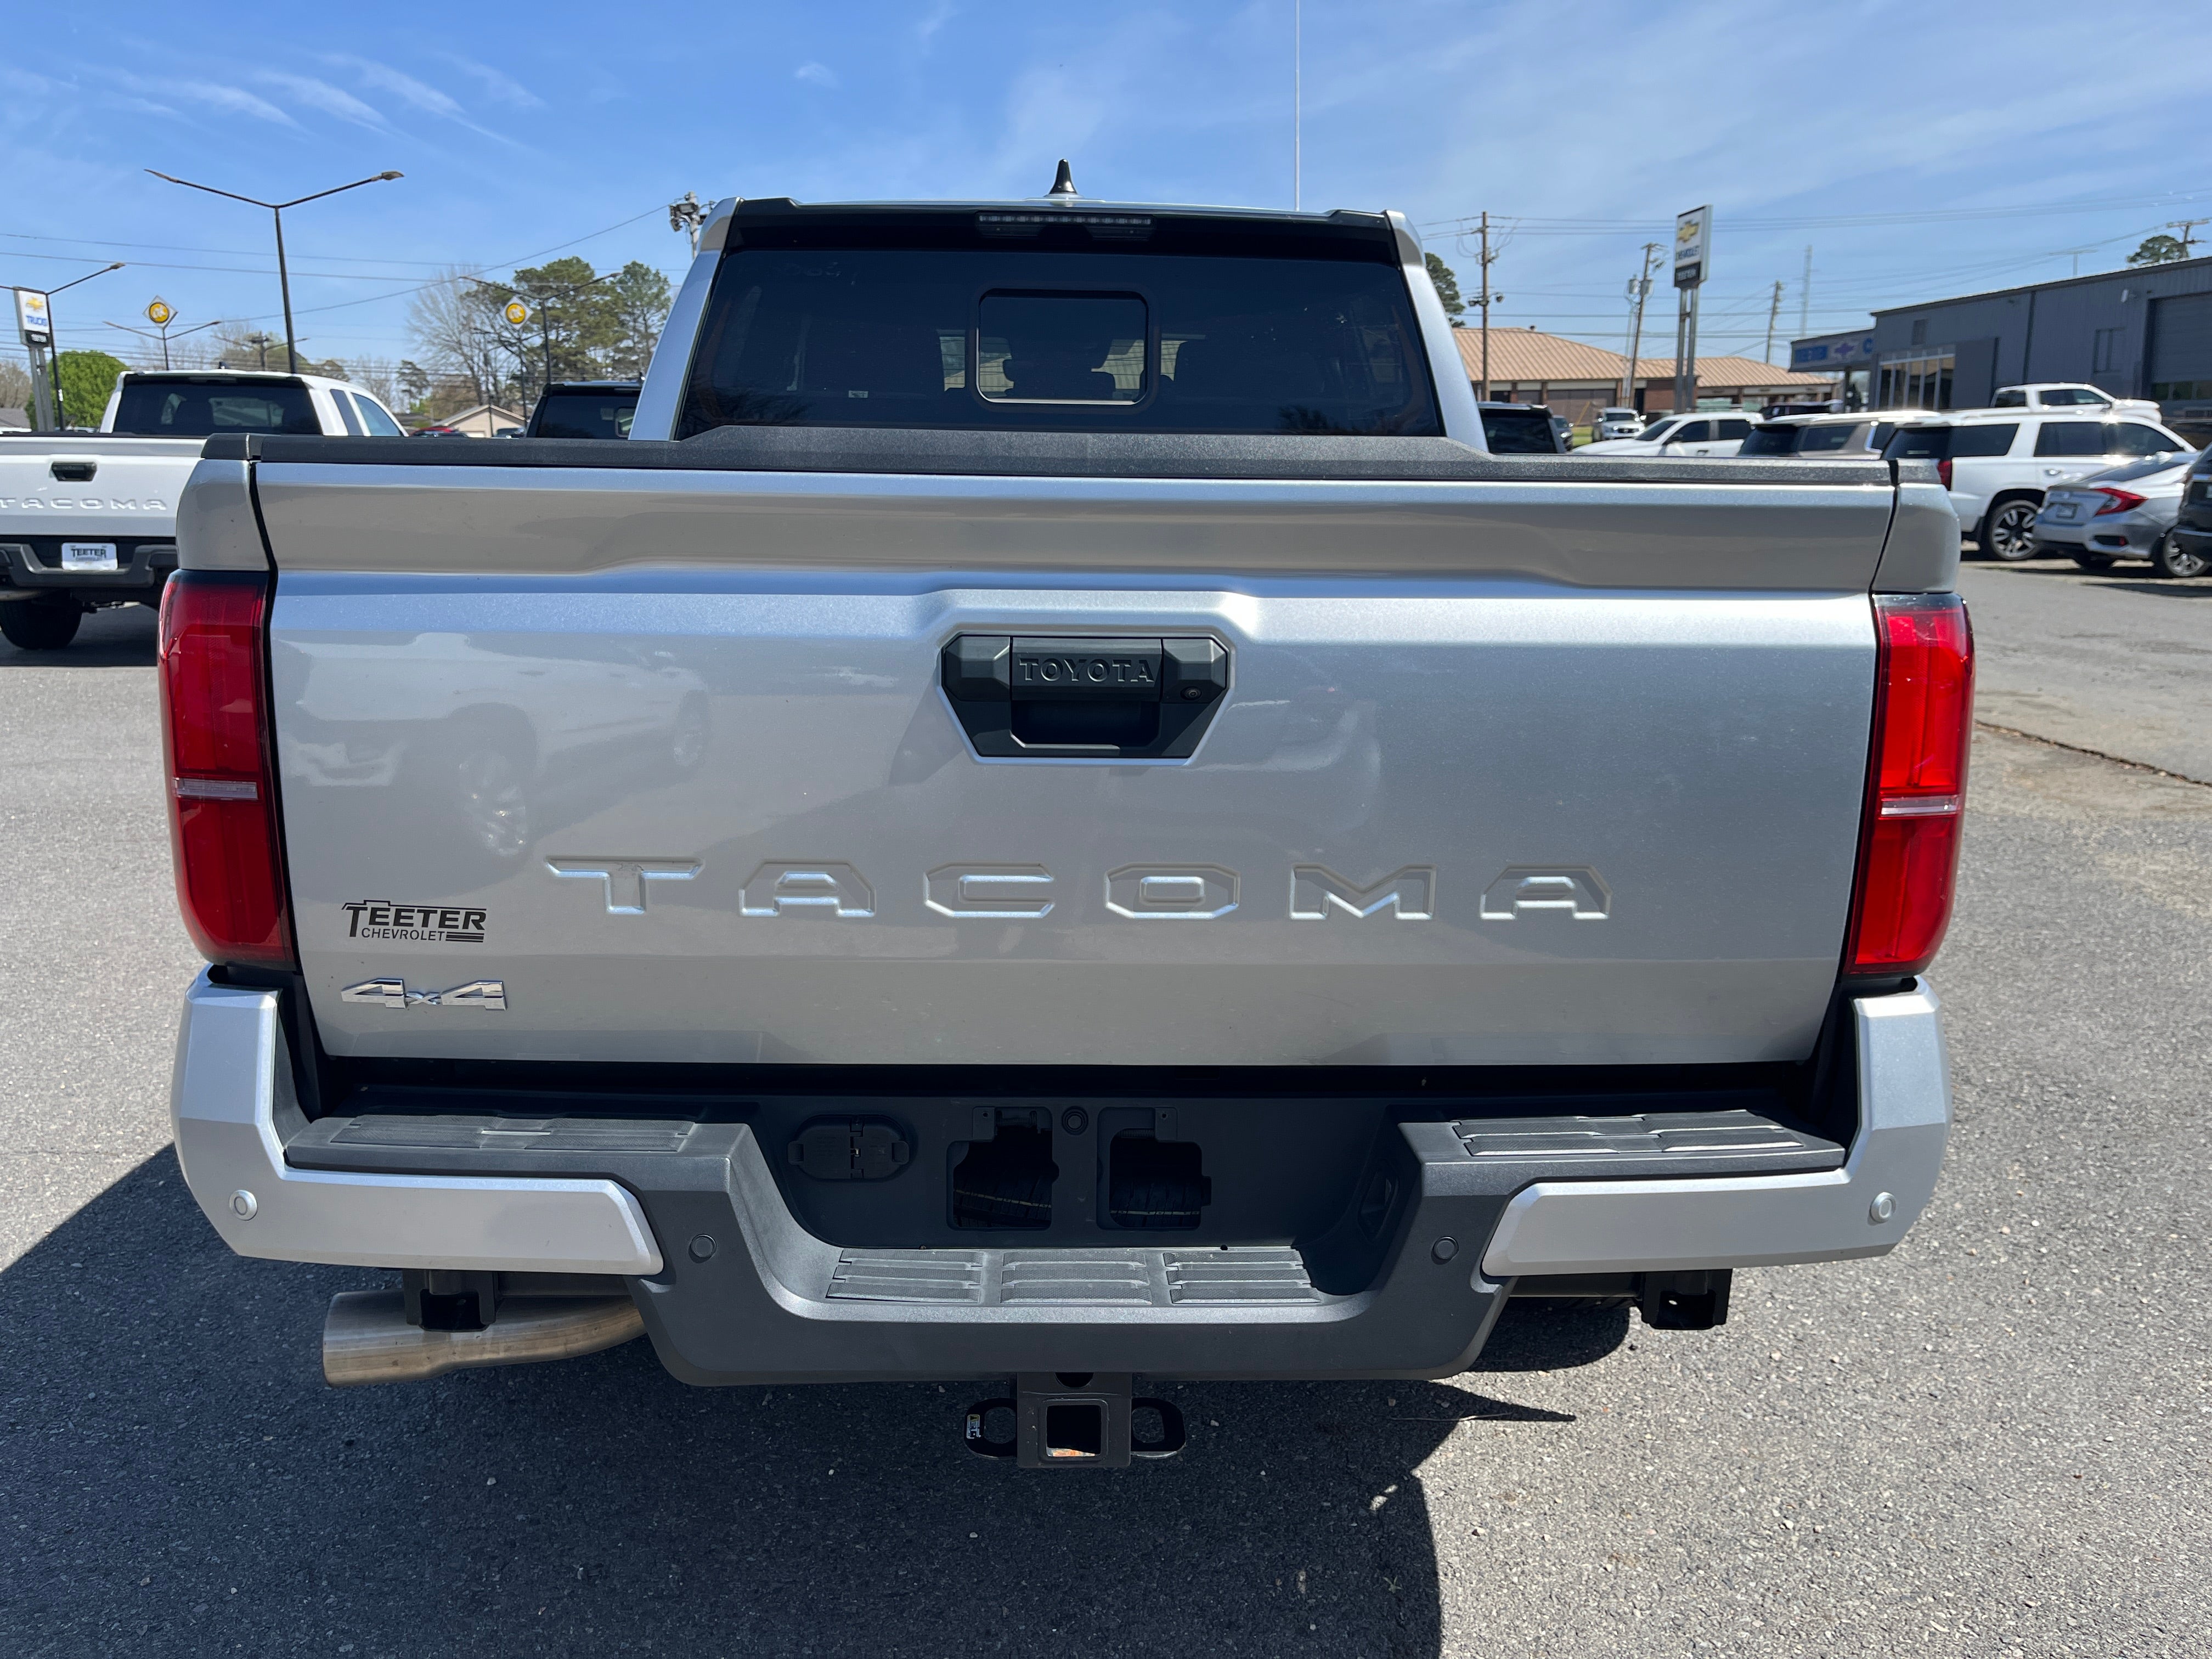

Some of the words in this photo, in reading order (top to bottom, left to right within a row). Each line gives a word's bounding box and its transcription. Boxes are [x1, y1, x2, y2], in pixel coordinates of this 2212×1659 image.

[0, 498, 167, 510] TACOMA
[71, 549, 106, 558] TEETER
[1019, 658, 1154, 682] TOYOTA
[545, 857, 1613, 920] TACOMA
[345, 905, 487, 938] TEETER
[361, 927, 445, 941] CHEVROLET
[340, 977, 508, 1011] 4x4
